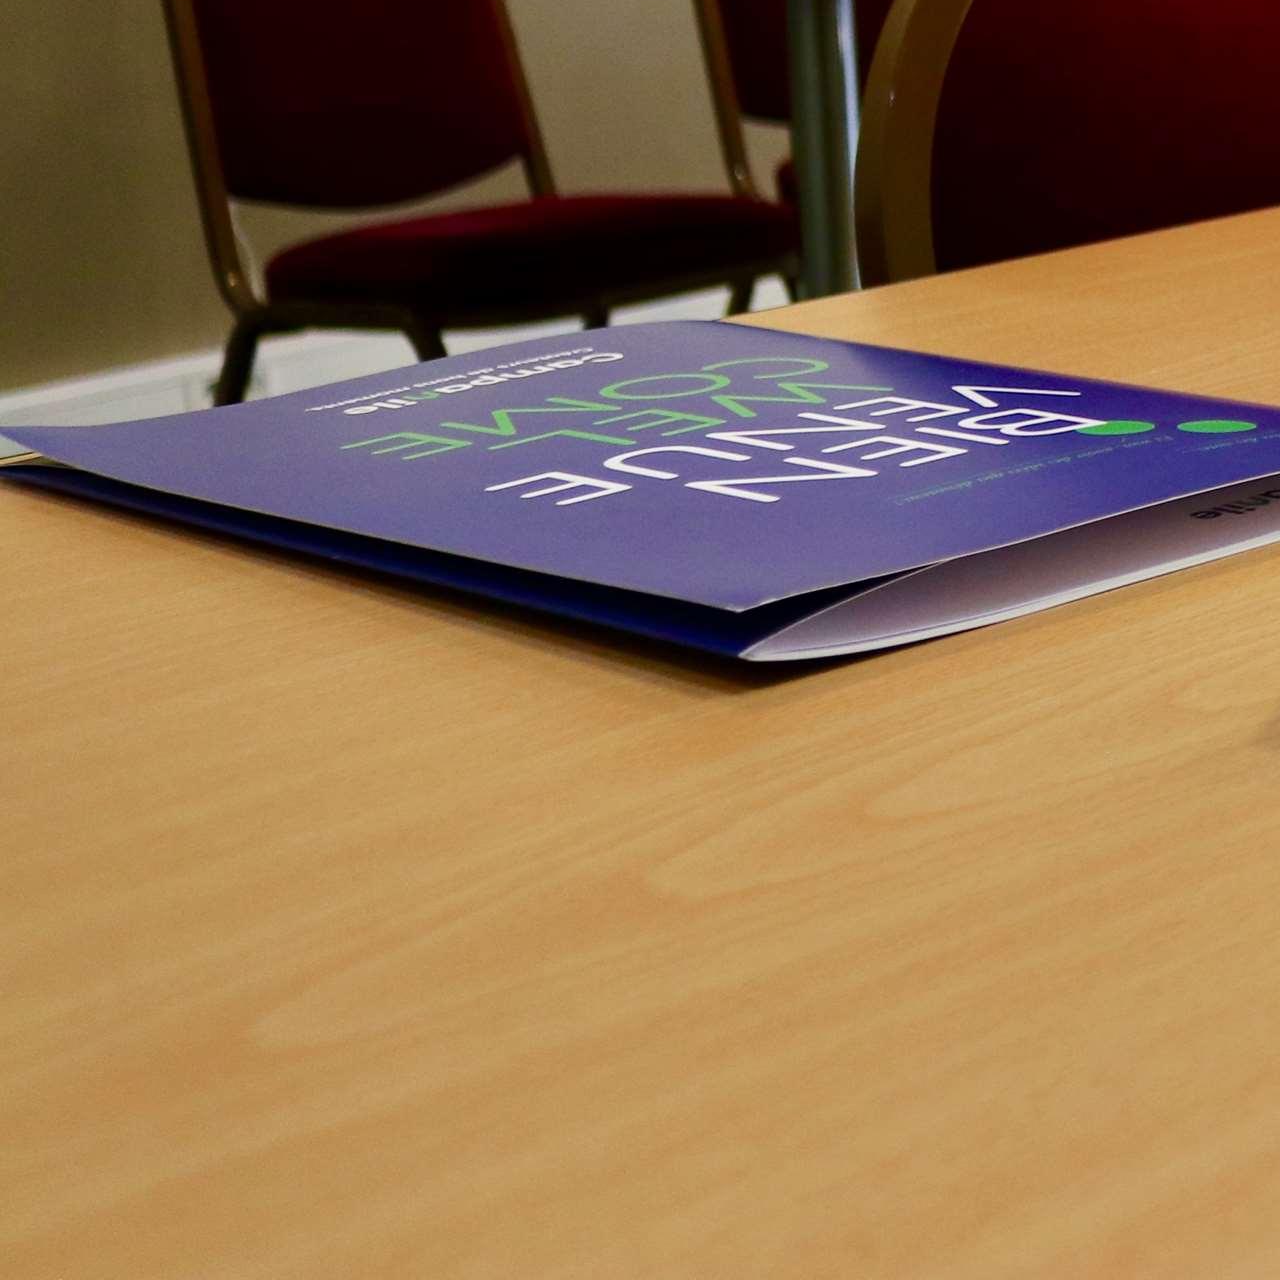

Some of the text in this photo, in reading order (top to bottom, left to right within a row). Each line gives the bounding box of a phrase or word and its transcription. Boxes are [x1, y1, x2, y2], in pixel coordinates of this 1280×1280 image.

[340, 354, 830, 462] COME
[343, 351, 624, 416] Campanile
[487, 380, 892, 451] WEL
[485, 383, 1082, 506] VENUE
[684, 408, 1107, 504] BIEN
